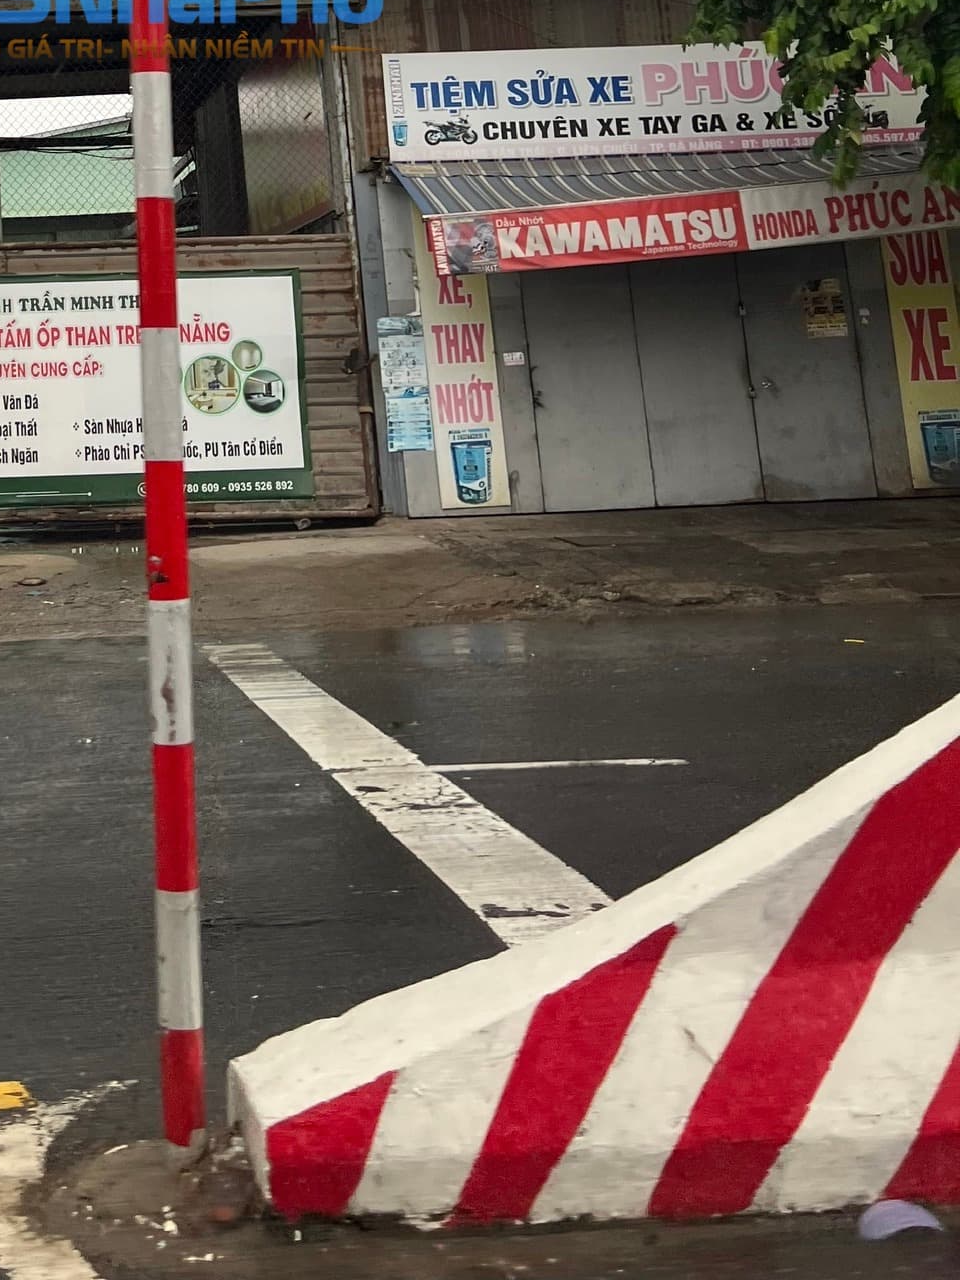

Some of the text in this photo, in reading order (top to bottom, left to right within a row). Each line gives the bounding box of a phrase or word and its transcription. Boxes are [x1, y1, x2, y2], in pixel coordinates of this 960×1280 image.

[410, 75, 496, 114] TIỆM
[507, 69, 575, 107] SỬA
[587, 75, 630, 103] XE
[483, 111, 798, 140] CHUYÊN XE TAY GA & XE
[752, 208, 819, 241] HONDA
[824, 181, 913, 233] PHÚC
[497, 207, 737, 259] KAWAMATSU
[642, 238, 739, 255] Japanese Technology
[19, 290, 65, 312] TRẦN
[71, 295, 113, 311] MINH
[39, 318, 60, 347] ỐP
[67, 325, 111, 346] THAN
[180, 313, 231, 343] NẴNG
[431, 323, 485, 365] THAY
[902, 308, 958, 381] XE
[31, 362, 68, 378] CUNG
[72, 354, 103, 377] CẤP:
[435, 374, 494, 425] NHỚT
